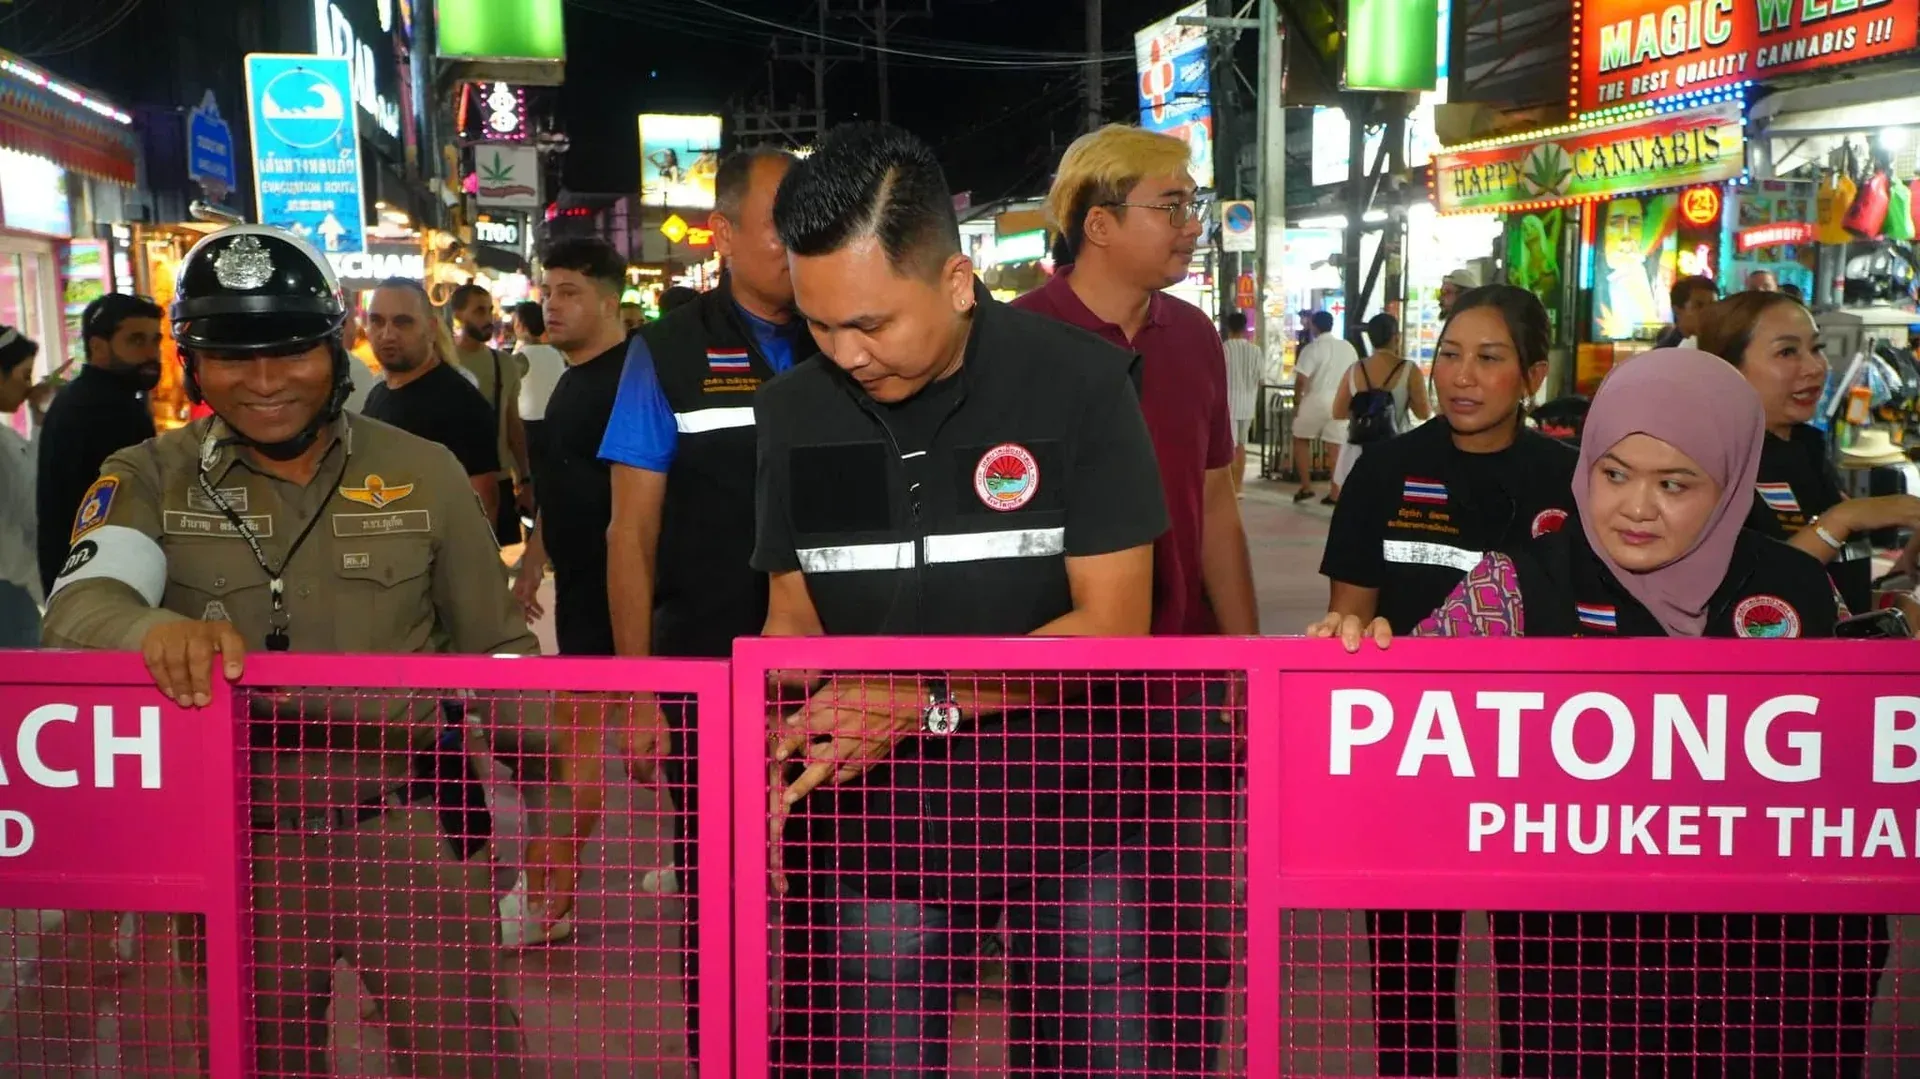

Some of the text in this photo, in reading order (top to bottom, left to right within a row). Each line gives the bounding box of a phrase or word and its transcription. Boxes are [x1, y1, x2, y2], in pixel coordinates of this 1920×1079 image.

[1598, 17, 1893, 103] THE BEST QUALITY CANNABIS !!!
[1599, 0, 1733, 72] MAGIC
[261, 181, 357, 195] EVACUATION ROUTE
[1454, 125, 1722, 198] HAPPY CANNABIS
[0, 703, 161, 789] CH
[1329, 688, 1823, 783] PATONG
[1468, 802, 1747, 857] PHUKET
